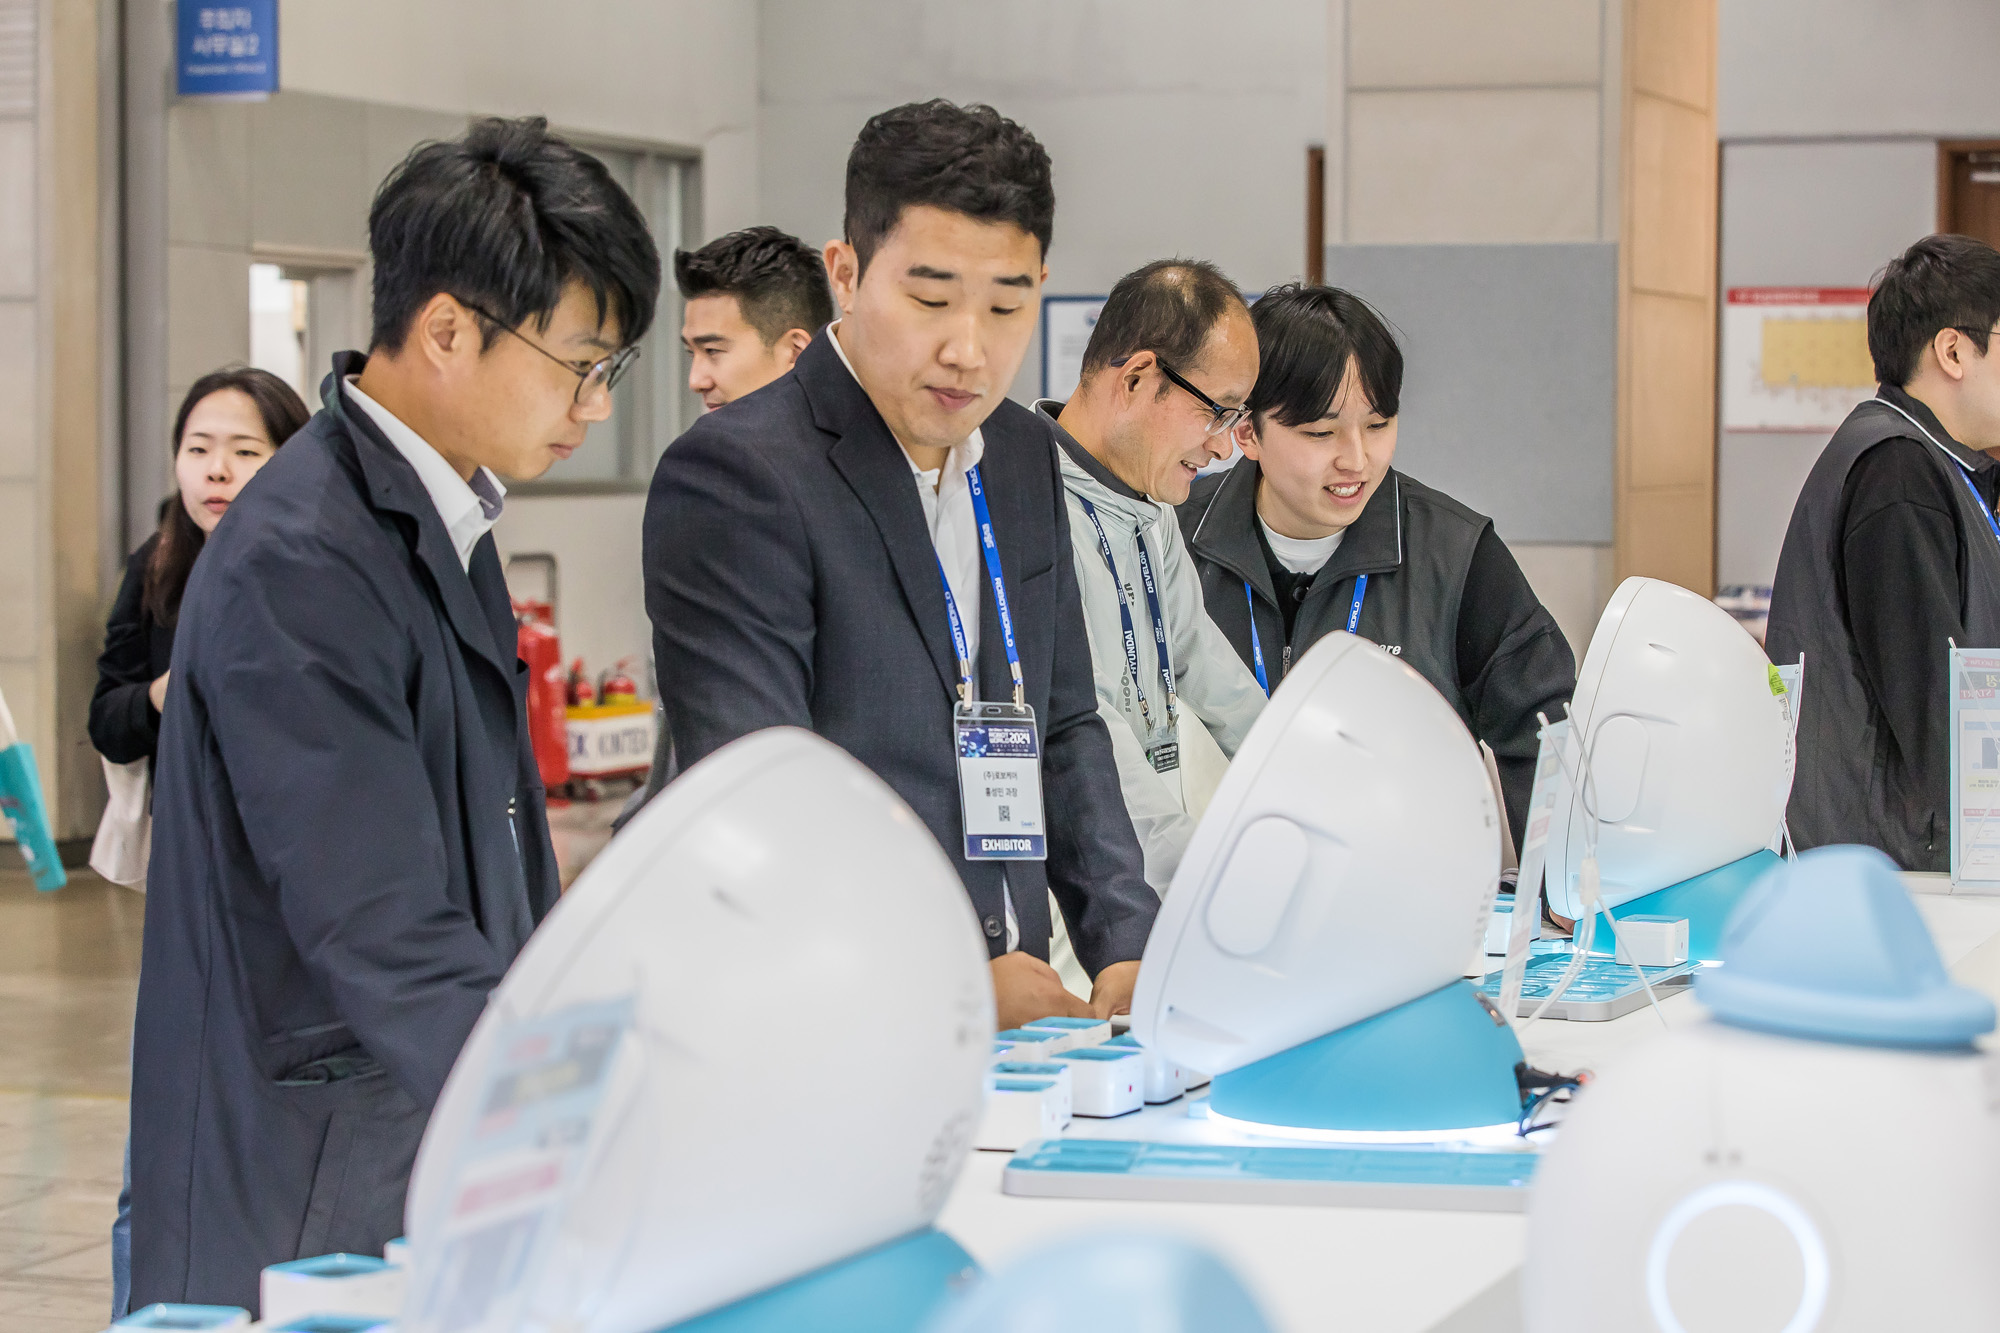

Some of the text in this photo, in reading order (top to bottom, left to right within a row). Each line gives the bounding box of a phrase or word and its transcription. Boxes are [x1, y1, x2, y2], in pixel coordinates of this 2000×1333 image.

[1090, 513, 1110, 556] DEVELON
[1139, 551, 1154, 594] DEVELON
[994, 577, 1014, 648] ROBOTWORLD
[1123, 630, 1138, 675] HYUNDAI
[1375, 643, 1402, 656] are
[1008, 732, 1030, 745] 2024
[981, 839, 1032, 851] EXHIBITOR
